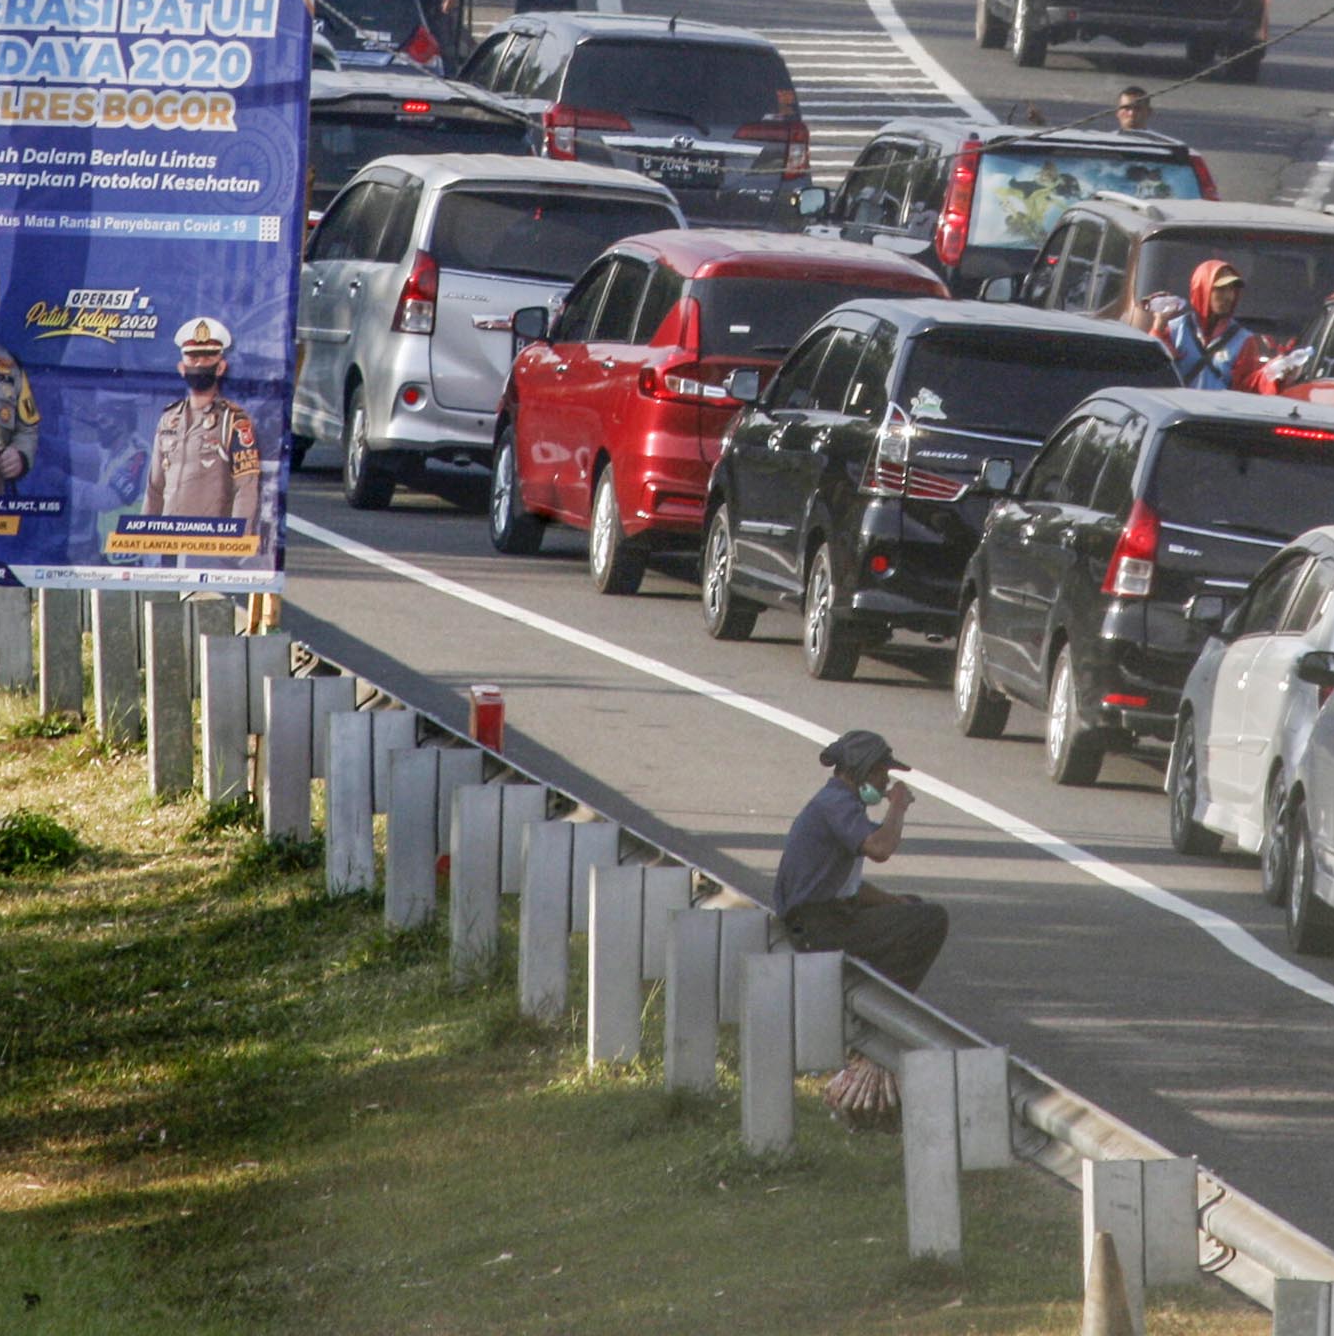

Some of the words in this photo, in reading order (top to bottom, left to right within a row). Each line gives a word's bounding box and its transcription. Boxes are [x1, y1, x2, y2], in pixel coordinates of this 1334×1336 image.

[128, 39, 252, 88] 2020
[98, 88, 237, 132] BOGOR
[22, 148, 86, 166] Dalam
[90, 149, 156, 168] Berlalu
[160, 151, 217, 169] Lintas
[79, 173, 157, 192] Protokol
[161, 175, 260, 194] Kesehatan
[24, 214, 56, 229] Mata
[60, 215, 101, 230] Rantai
[104, 216, 180, 234] Penyebaran
[183, 217, 219, 232] Covid
[233, 220, 247, 233] 19
[71, 292, 128, 306] OPERASI
[25, 301, 69, 328] Patuh
[120, 315, 158, 330] 2020
[126, 521, 146, 531] AKP
[147, 521, 174, 531] FITRA
[175, 522, 216, 533] ZUANDA,
[111, 540, 141, 549] KASAT
[143, 541, 179, 550] LANTAS
[181, 542, 216, 551] POLRES
[219, 542, 252, 552] BOGOR
